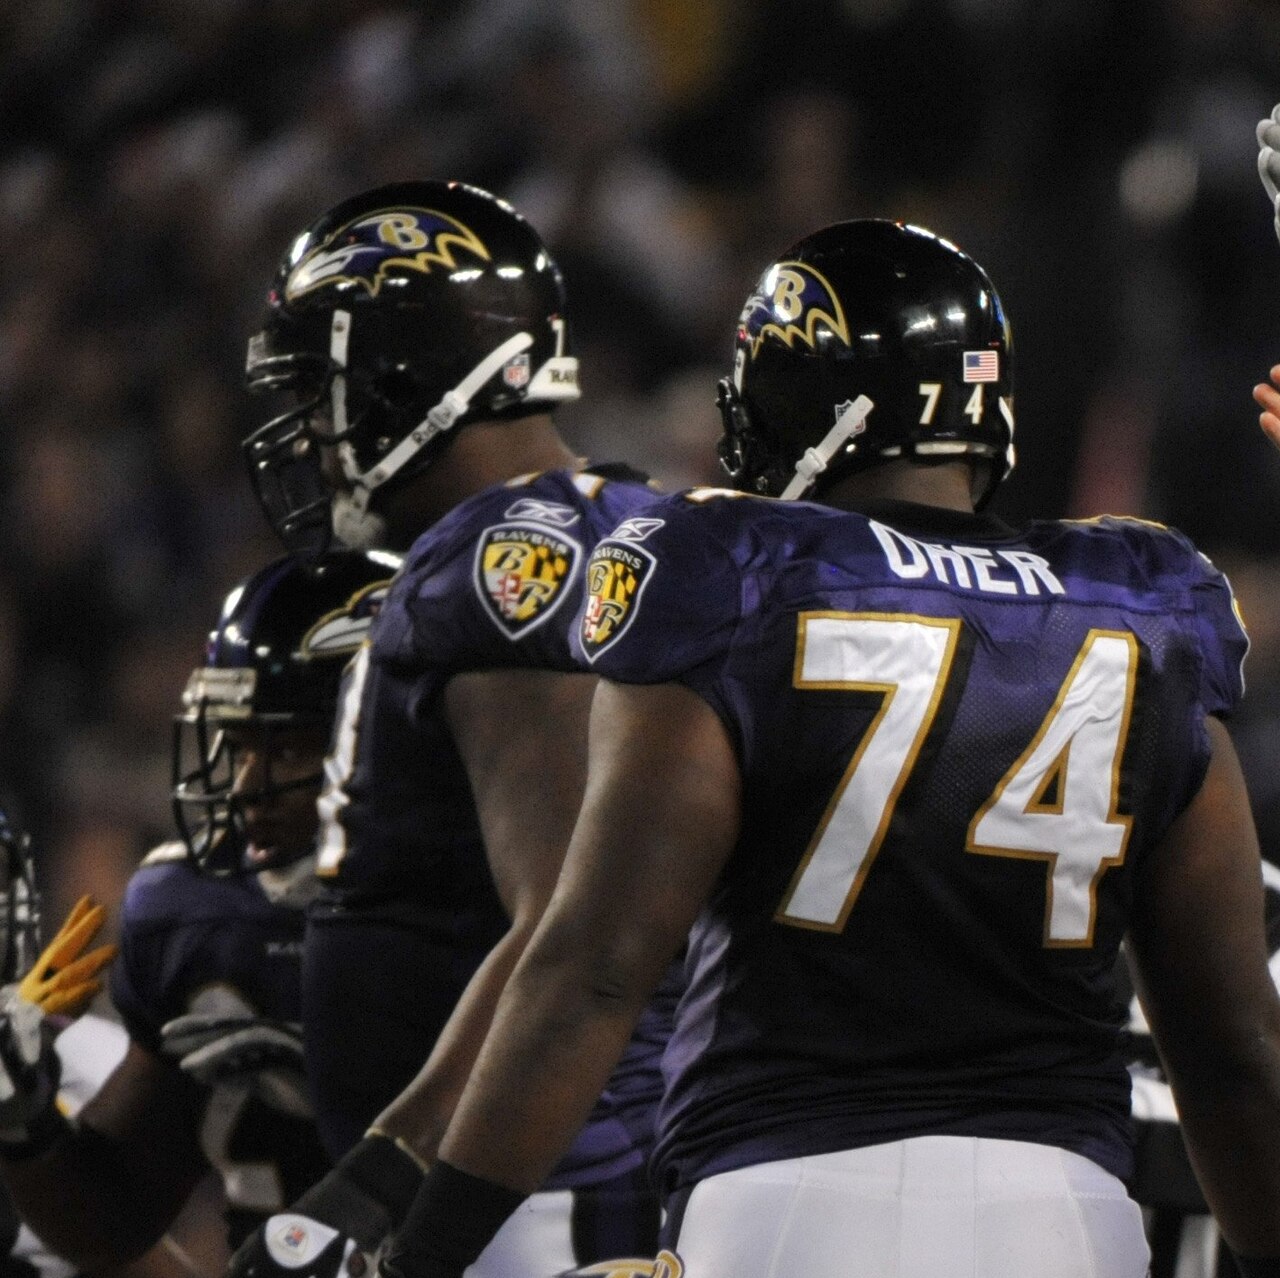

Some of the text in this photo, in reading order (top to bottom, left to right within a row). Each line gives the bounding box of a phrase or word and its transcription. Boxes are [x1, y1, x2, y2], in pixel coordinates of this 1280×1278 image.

[919, 383, 986, 425] 74
[492, 531, 568, 554] RAVENS
[778, 611, 1140, 949] 74
